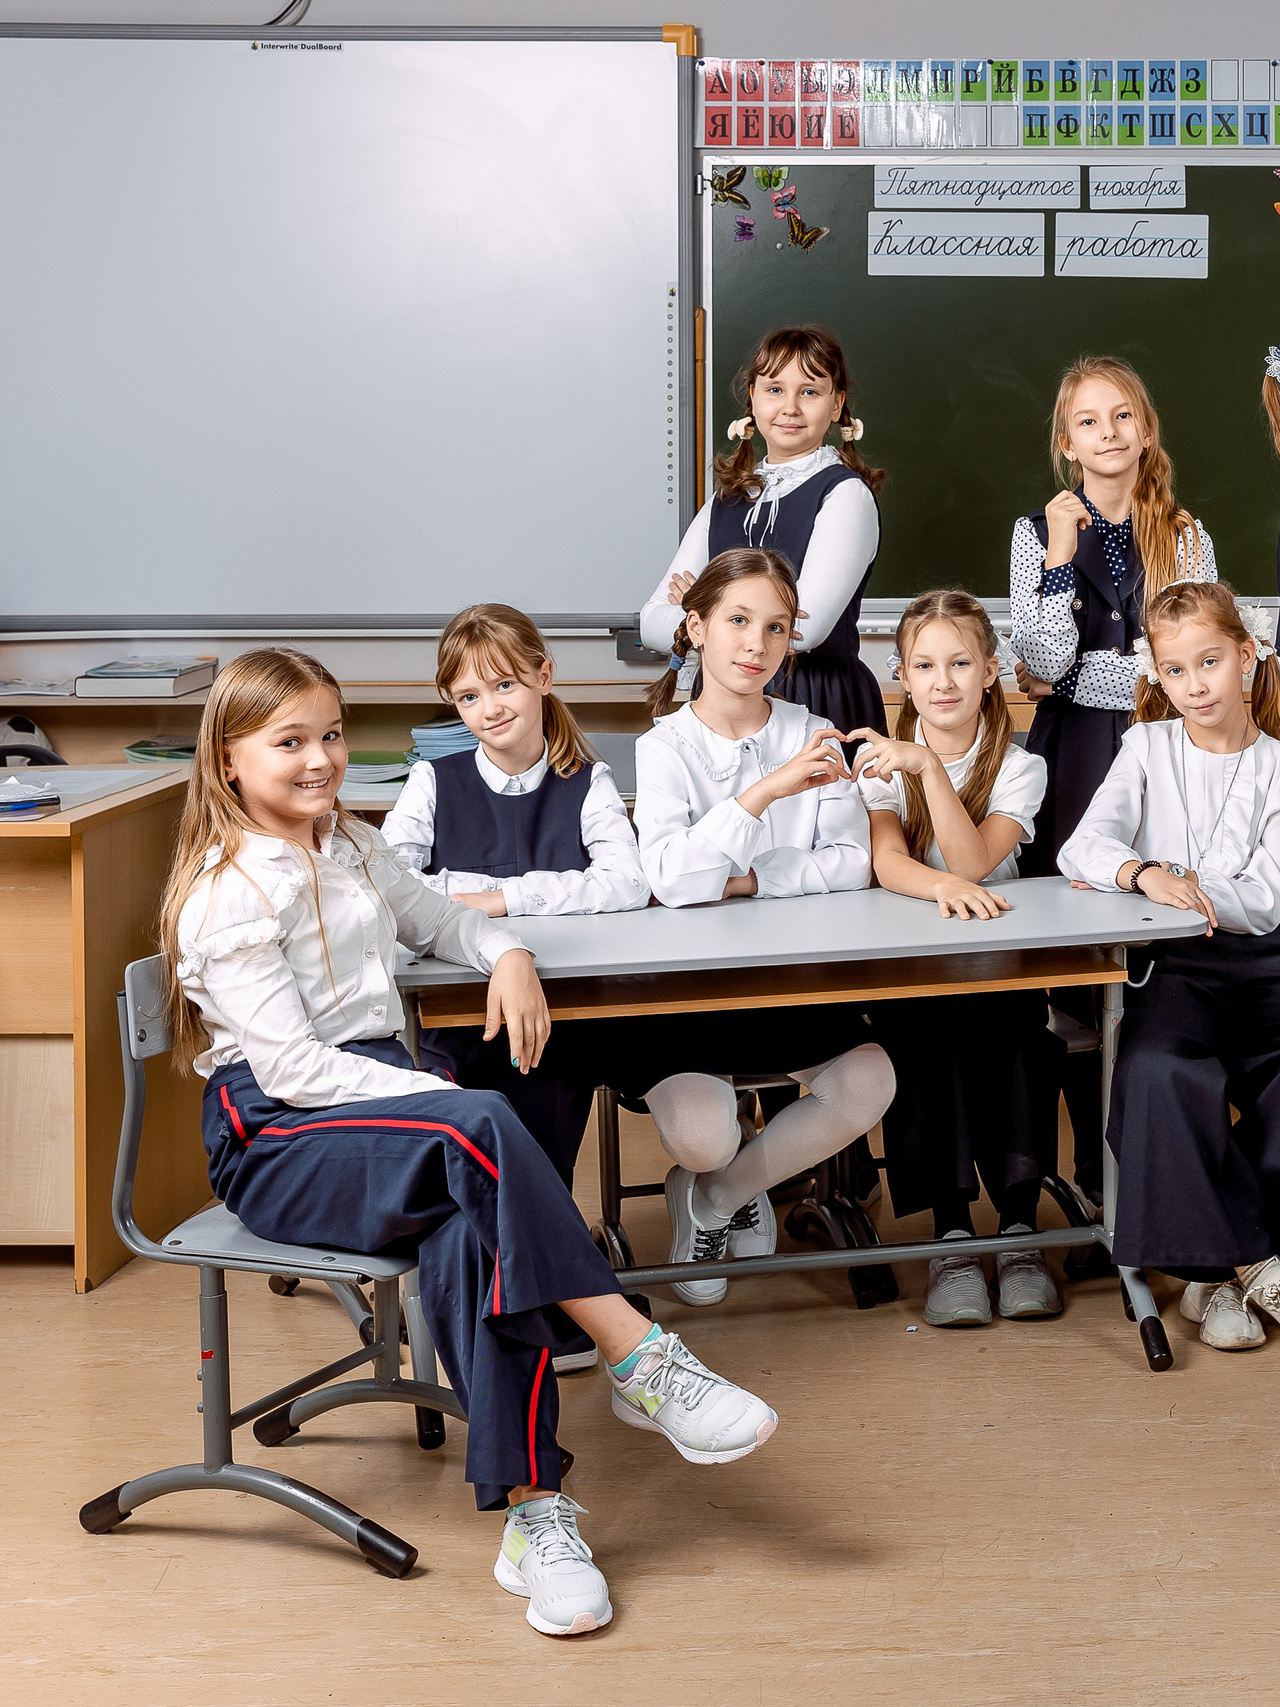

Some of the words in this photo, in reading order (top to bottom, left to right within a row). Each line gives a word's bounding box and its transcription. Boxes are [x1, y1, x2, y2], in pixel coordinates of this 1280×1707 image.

[708, 69, 730, 93] А
[740, 69, 760, 94] О
[772, 69, 792, 93] У
[899, 69, 925, 93] М
[931, 69, 954, 93] Н
[962, 69, 981, 93] Р
[994, 62, 1016, 93] Й
[1026, 69, 1045, 93] Б
[1059, 69, 1077, 93] В
[1091, 69, 1108, 93] Г
[1120, 69, 1141, 100] Д
[1149, 68, 1176, 93] Ж
[1185, 68, 1201, 93] З
[708, 114, 730, 138] Я
[742, 109, 760, 138] Ё
[769, 114, 796, 139] Ю
[804, 114, 826, 138] И
[838, 114, 856, 138] Е
[1026, 114, 1048, 138] П
[1056, 113, 1080, 138] Ф
[1090, 114, 1110, 138] К
[1122, 114, 1140, 138] Т
[1150, 114, 1176, 138] Ш
[1185, 113, 1203, 139] С
[1214, 113, 1237, 137] Х
[1246, 113, 1269, 143] Ц
[880, 167, 1075, 206] Пятнадцатое
[1094, 167, 1181, 207] ноября
[873, 218, 1040, 256] Классная
[1059, 220, 1204, 272] работа
